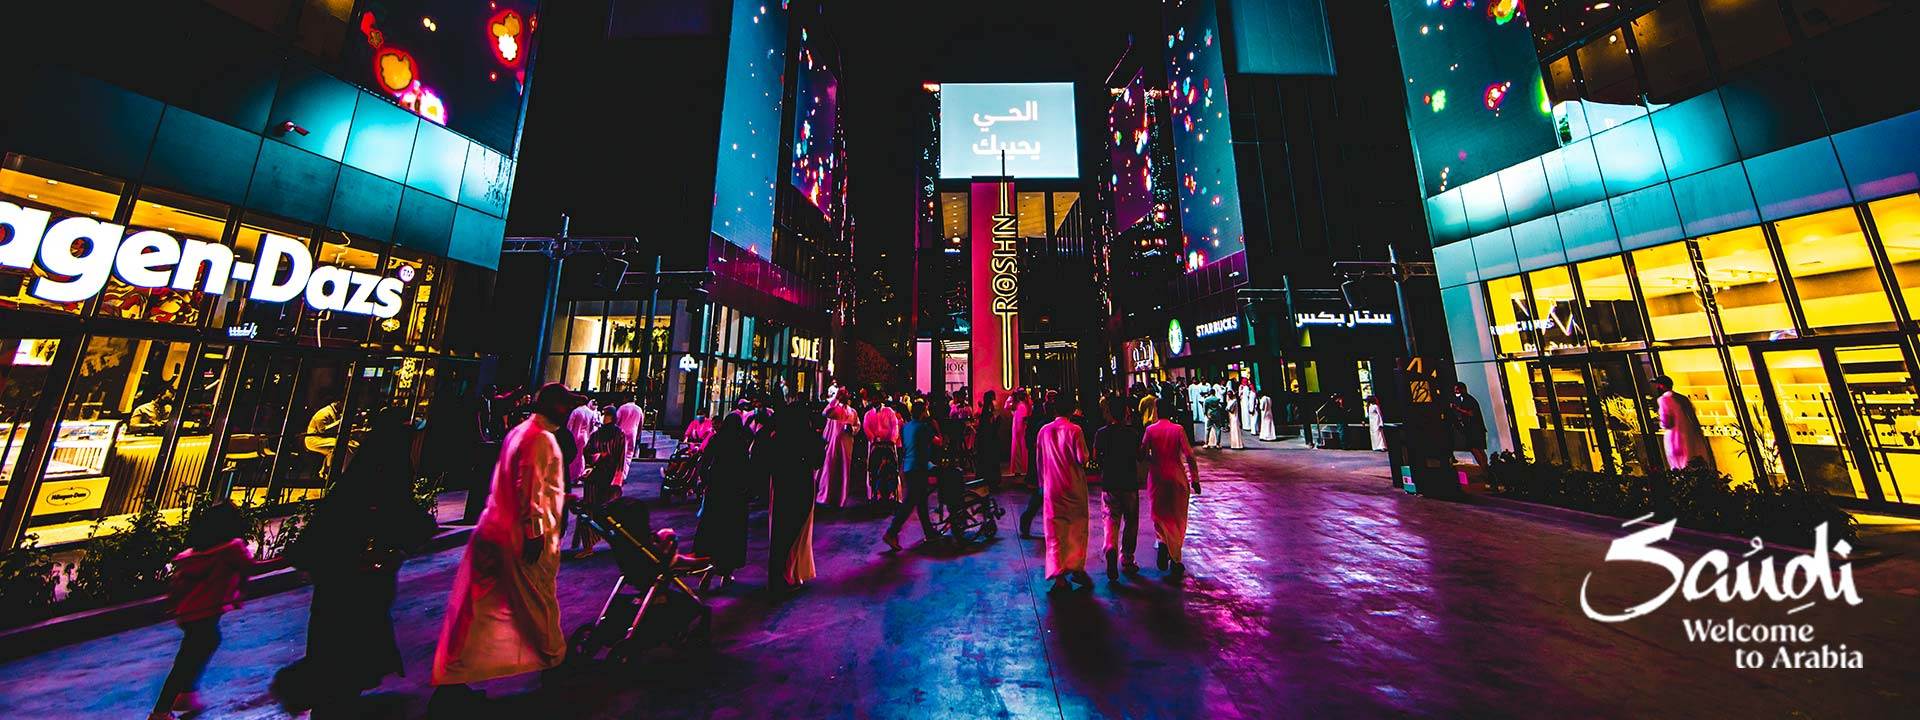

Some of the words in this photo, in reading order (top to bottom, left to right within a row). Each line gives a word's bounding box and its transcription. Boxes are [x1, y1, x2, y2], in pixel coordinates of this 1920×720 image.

[973, 100, 1038, 132] الحي
[972, 134, 1041, 160] يحييك
[992, 214, 1018, 315] ROSHN
[1196, 316, 1237, 337] STARBUCKS
[1295, 310, 1392, 327] ستاربكس
